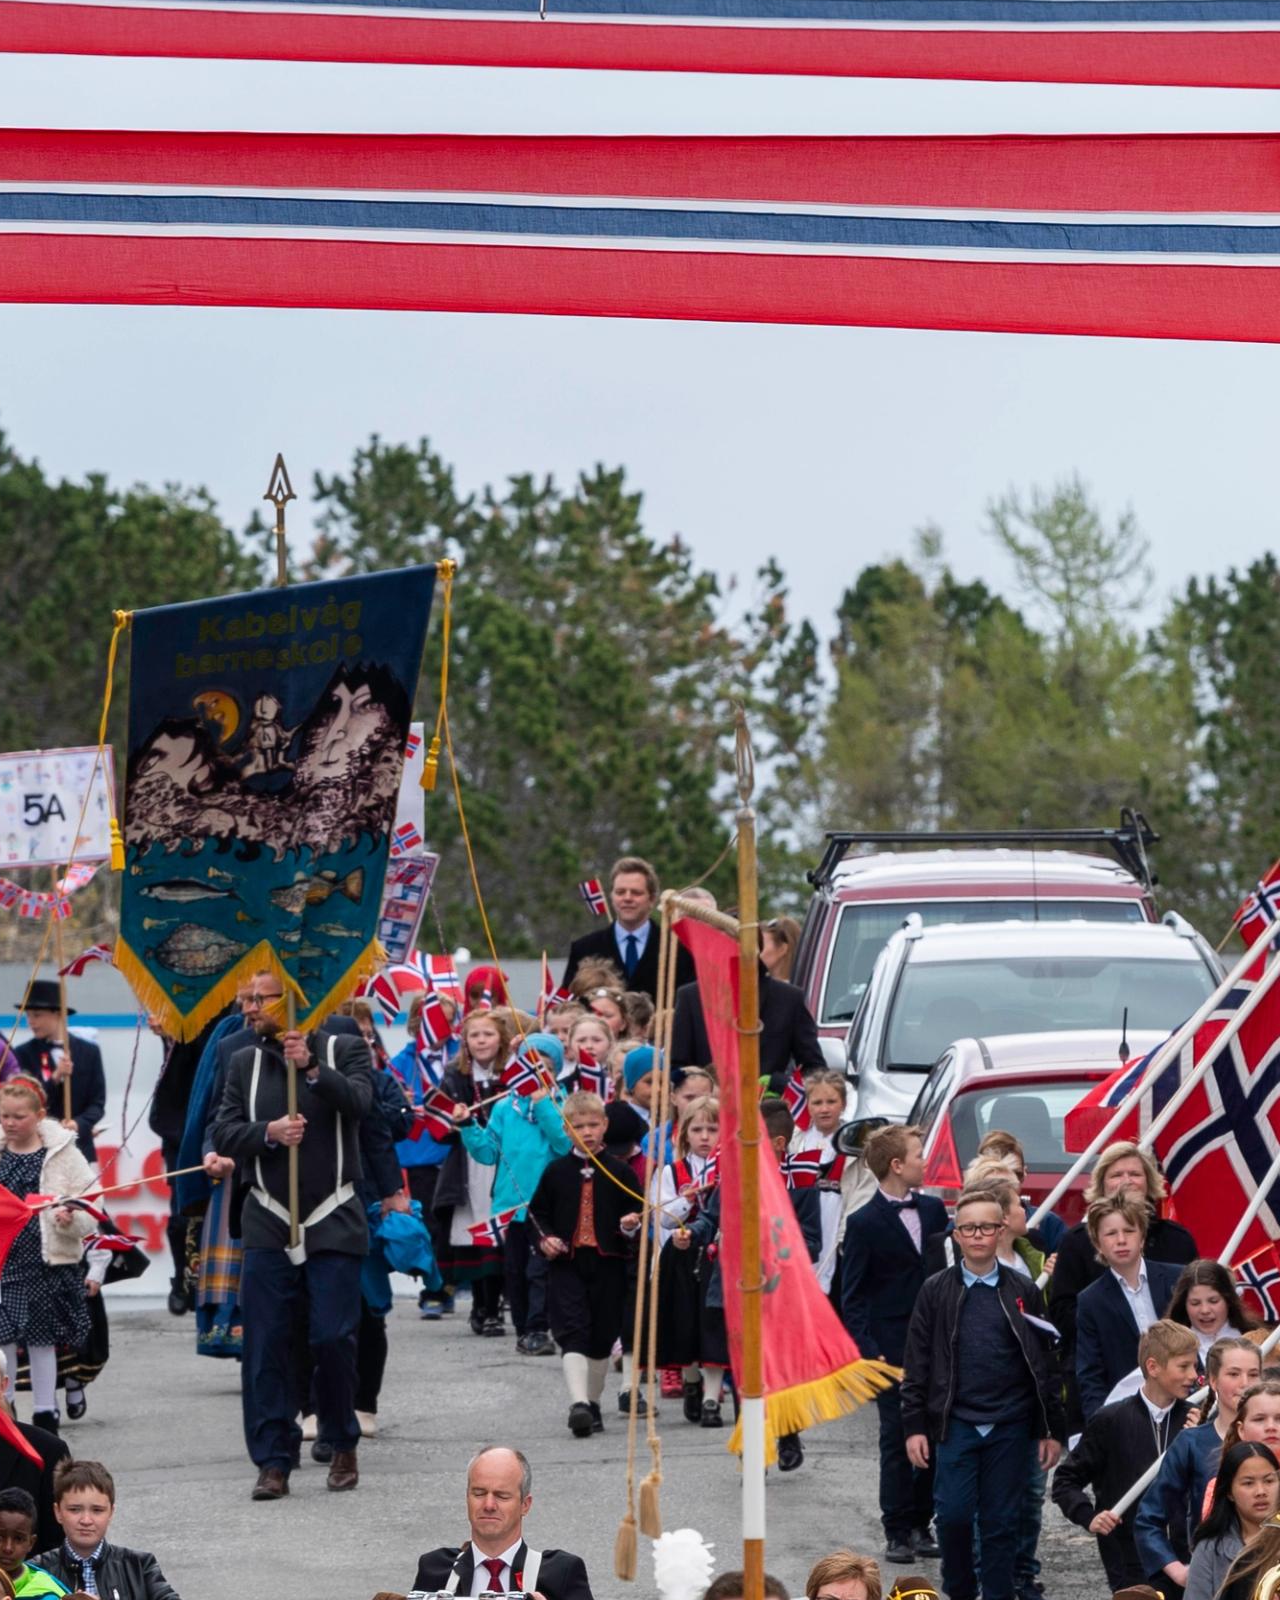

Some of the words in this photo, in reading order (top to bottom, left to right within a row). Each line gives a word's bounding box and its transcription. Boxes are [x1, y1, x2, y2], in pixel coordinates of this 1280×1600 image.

[199, 595, 362, 643] Kabelvåg
[175, 633, 363, 678] barneskole
[23, 793, 66, 826] 5A
